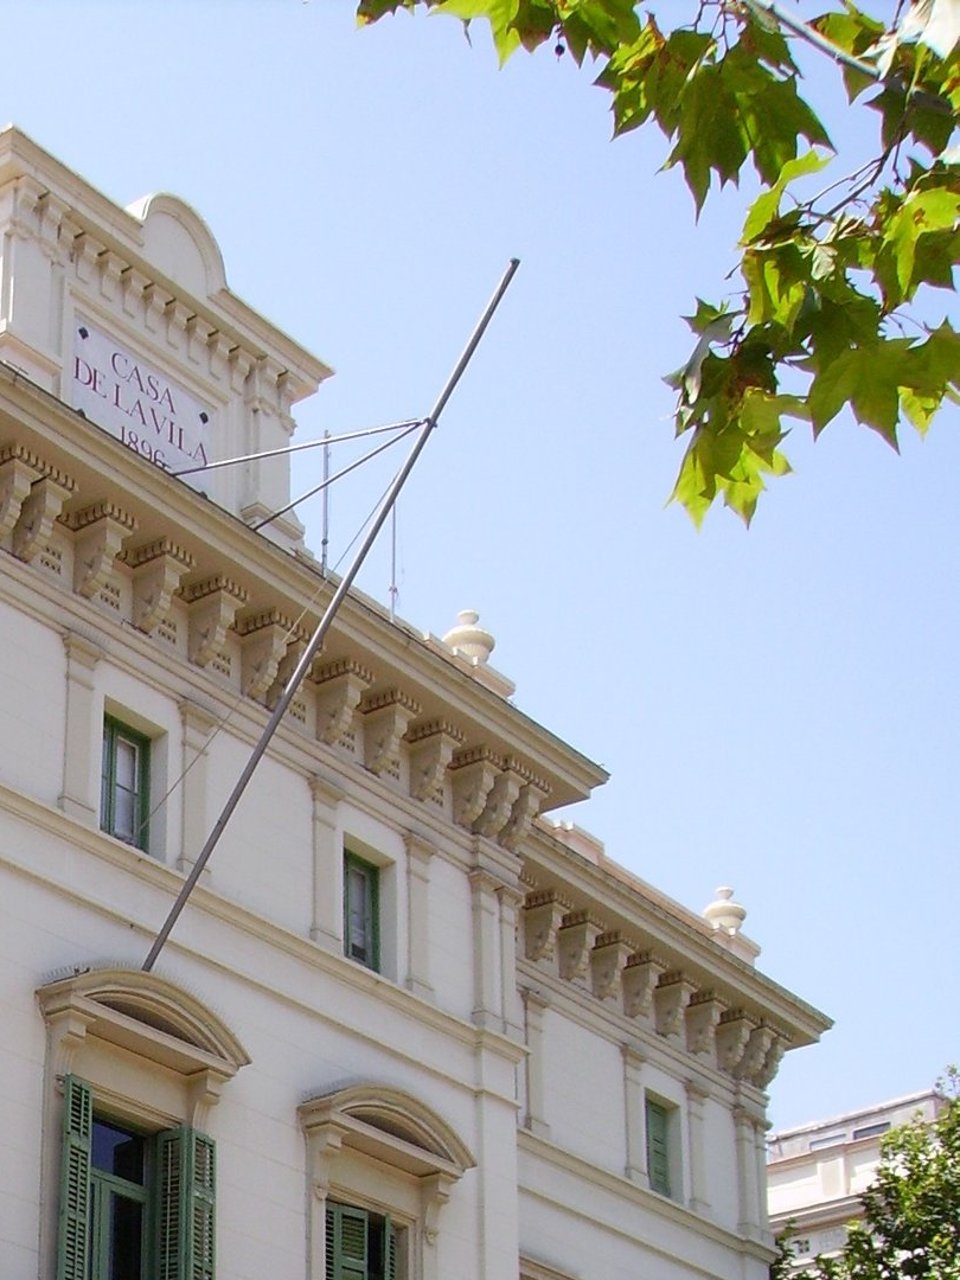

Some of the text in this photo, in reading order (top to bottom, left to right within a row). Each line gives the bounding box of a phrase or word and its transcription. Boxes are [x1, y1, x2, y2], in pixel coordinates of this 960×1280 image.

[73, 356, 208, 467] DE LA VILA
[111, 352, 176, 415] CASA
[121, 426, 166, 466] 1896
